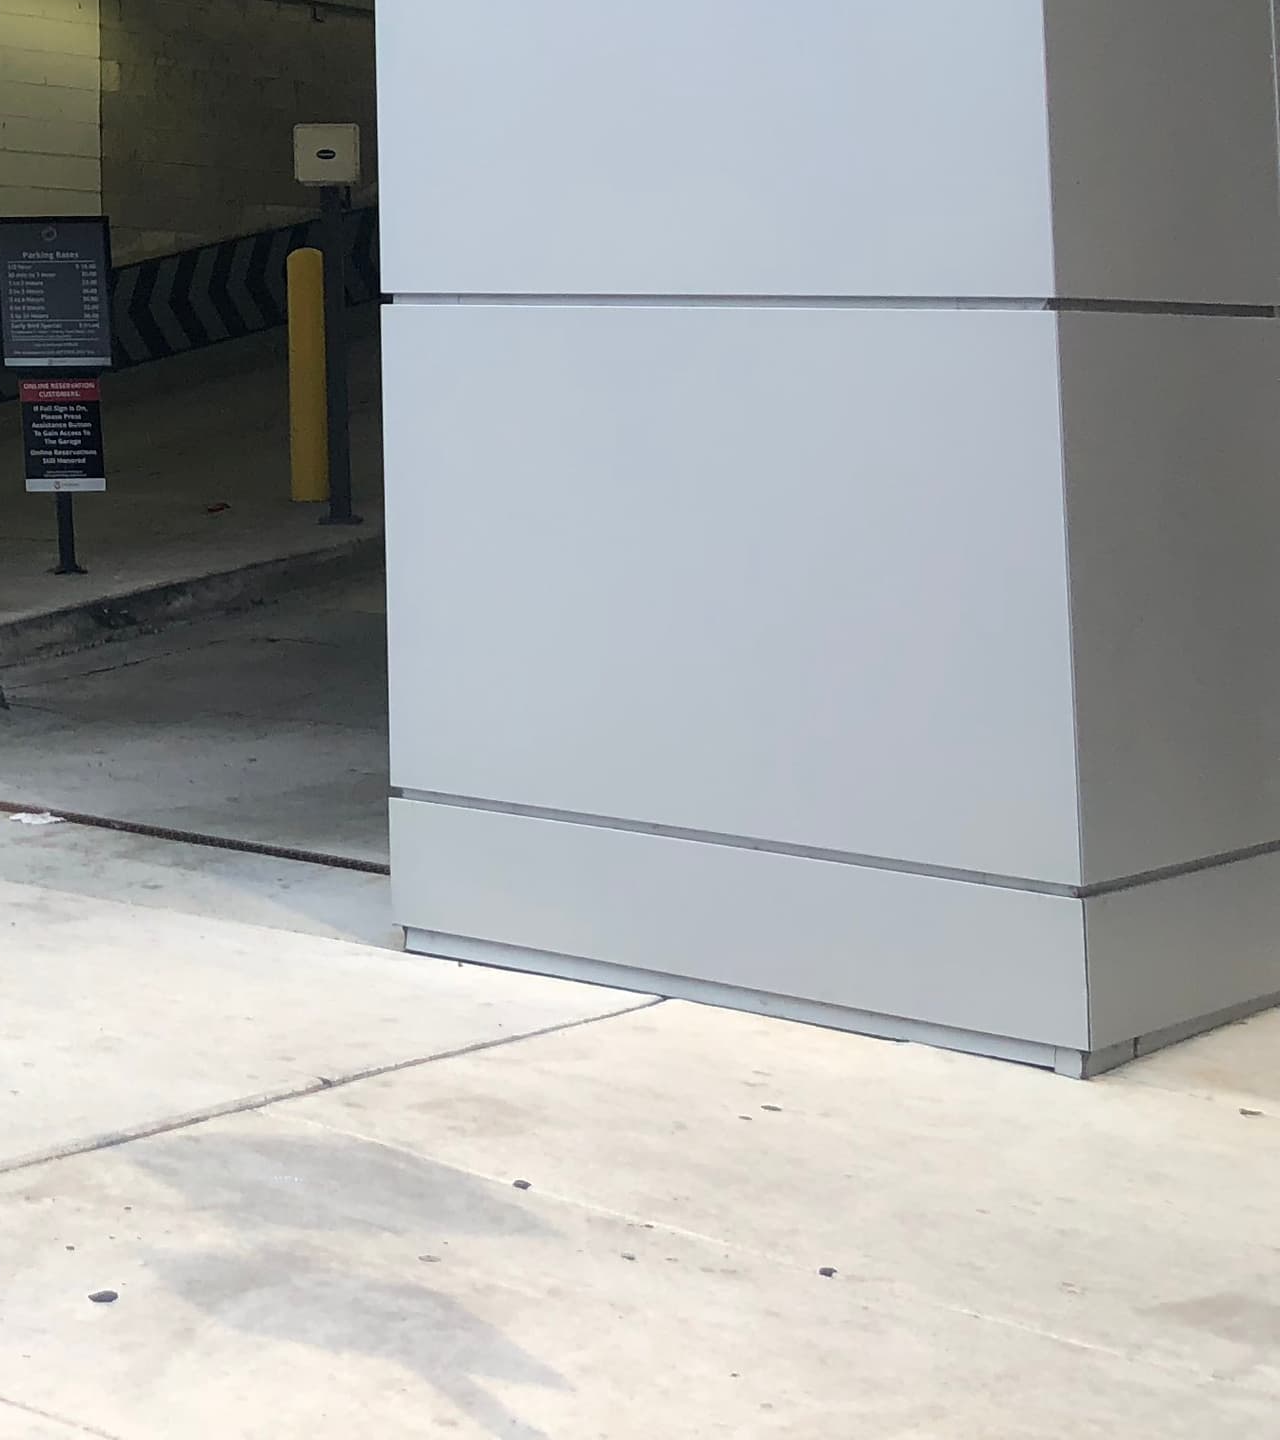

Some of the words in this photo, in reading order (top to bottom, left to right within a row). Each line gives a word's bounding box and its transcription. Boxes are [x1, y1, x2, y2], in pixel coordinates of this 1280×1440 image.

[22, 251, 54, 260] Parking
[50, 382, 95, 390] RESERVATION
[53, 405, 68, 413] Sign
